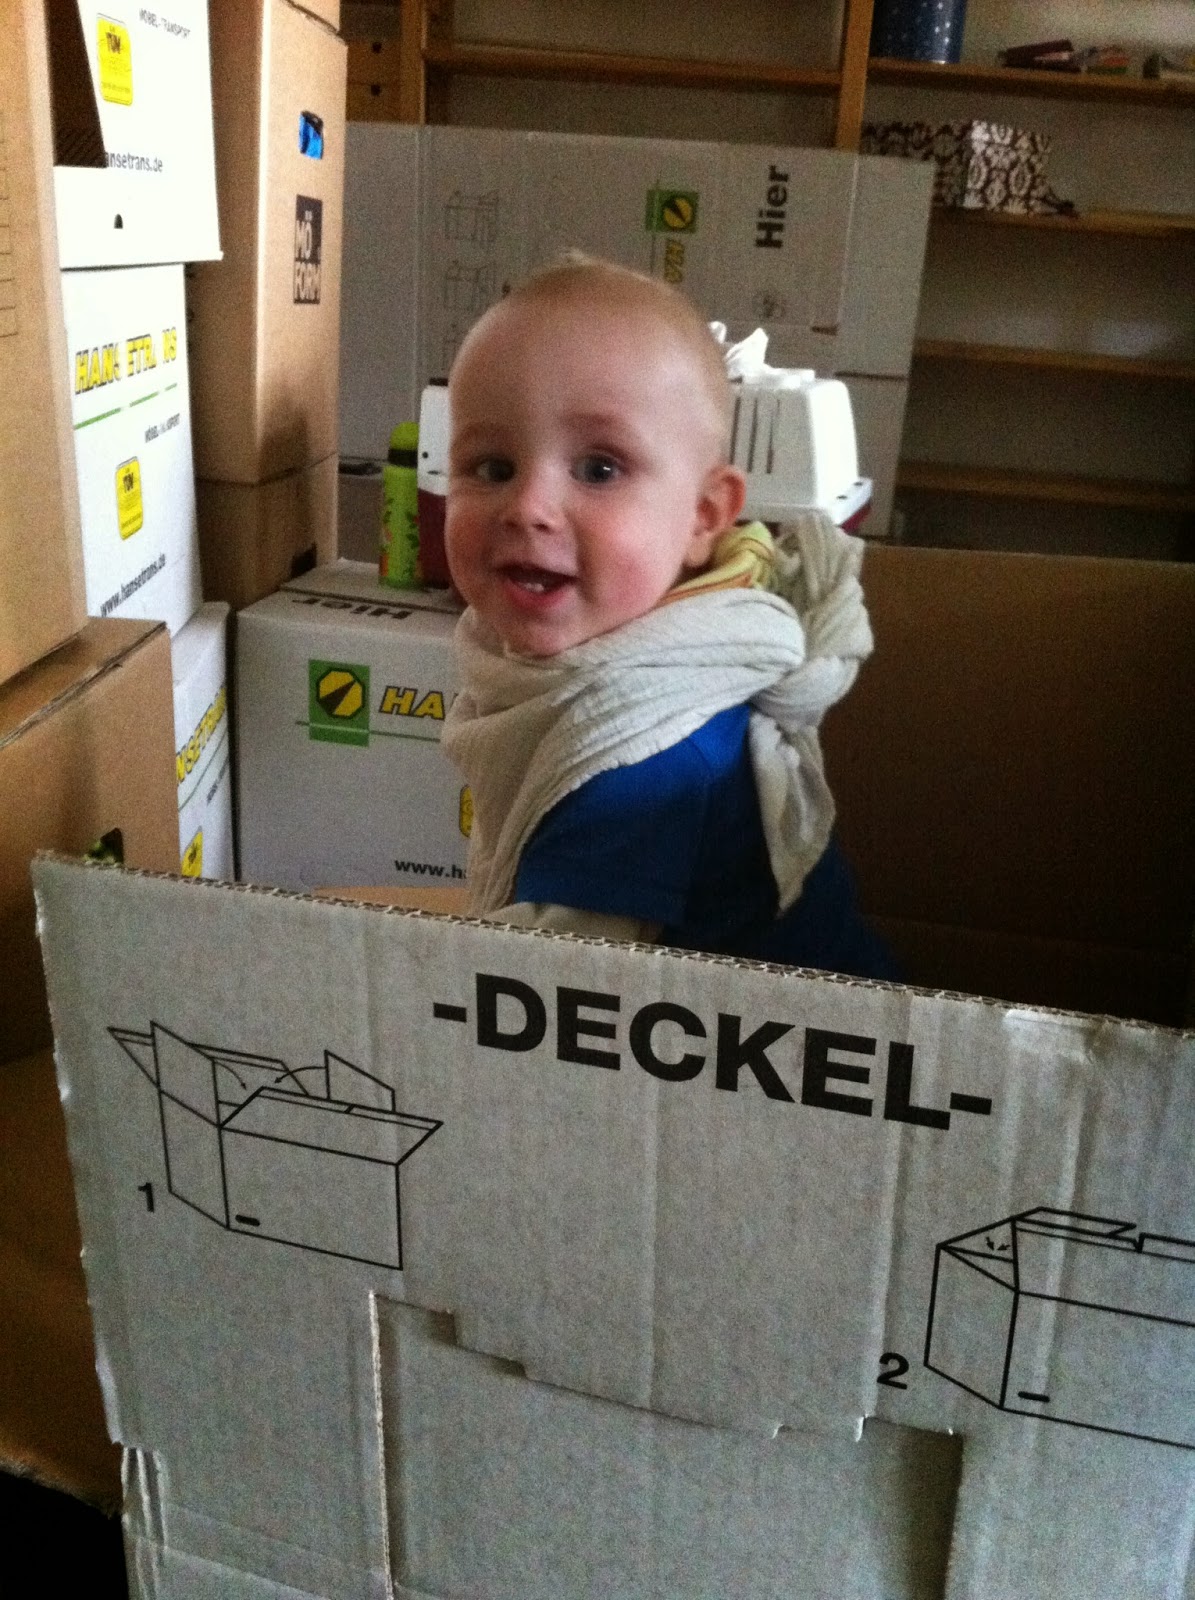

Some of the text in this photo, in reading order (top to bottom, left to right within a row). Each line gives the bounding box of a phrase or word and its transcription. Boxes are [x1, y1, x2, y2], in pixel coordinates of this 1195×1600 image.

[755, 164, 789, 248] Hier
[379, 686, 458, 722] HA
[433, 972, 992, 1131] -DECKEL-
[137, 1182, 154, 1213] 1
[876, 1352, 910, 1390] 2
